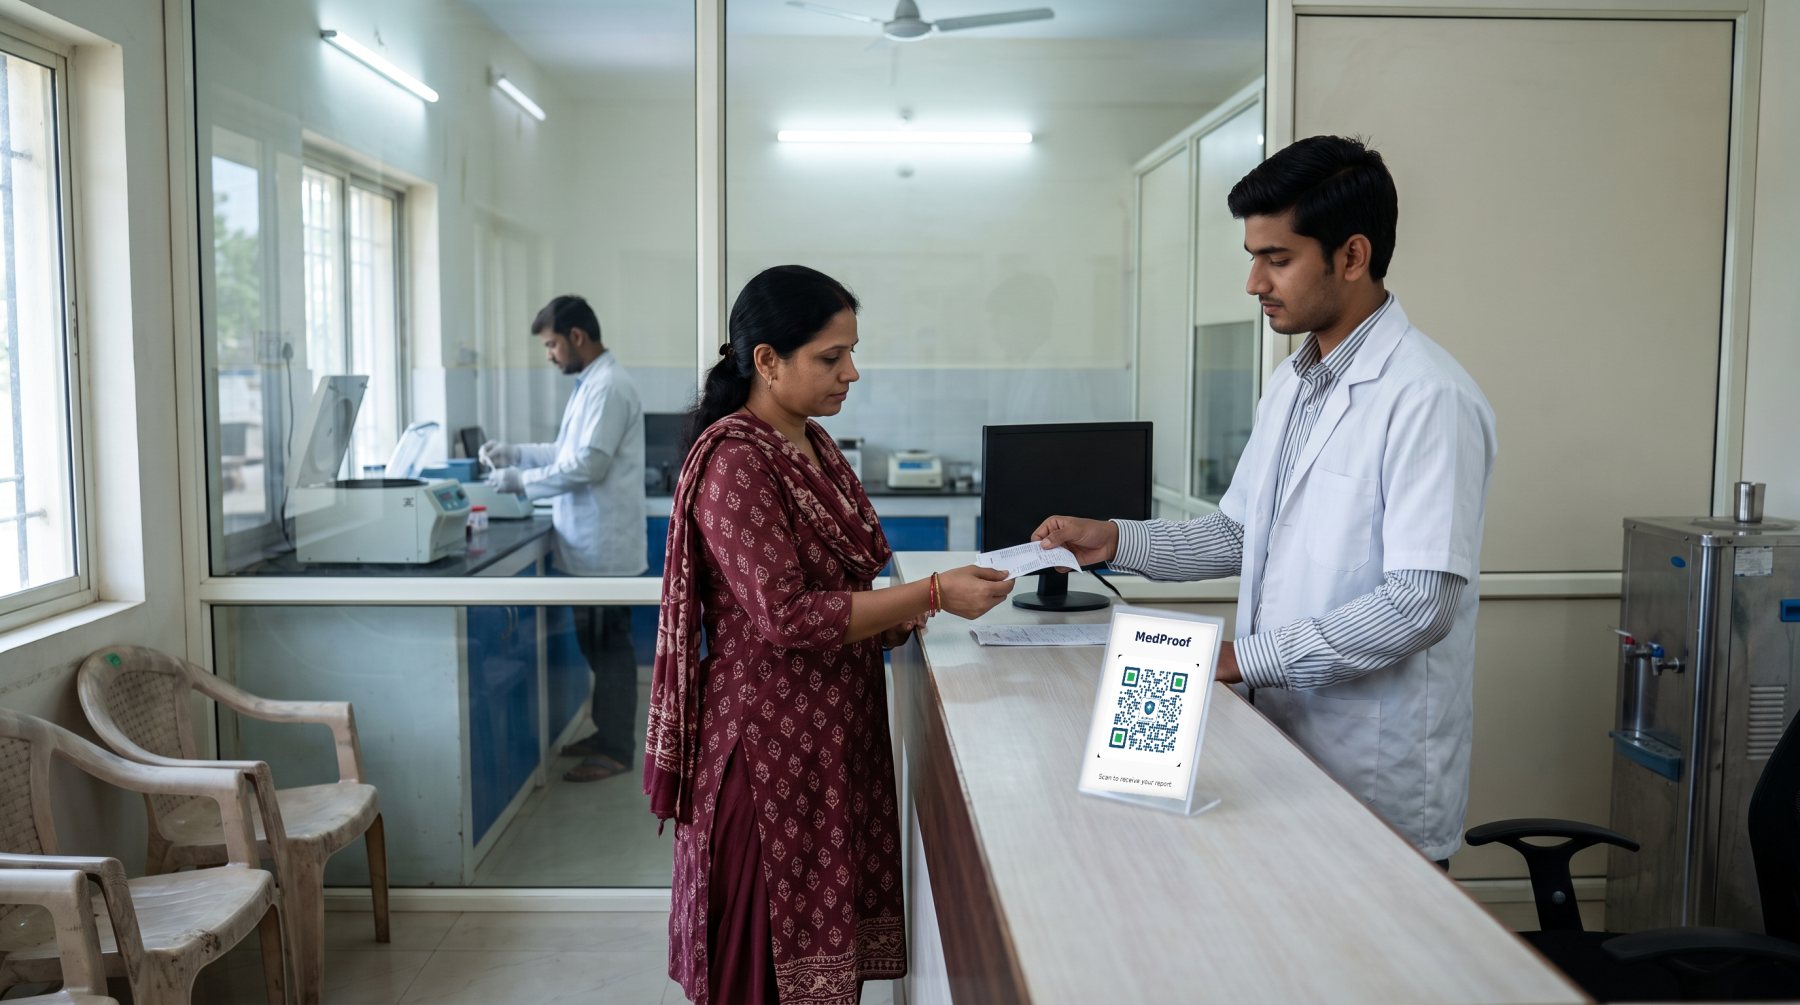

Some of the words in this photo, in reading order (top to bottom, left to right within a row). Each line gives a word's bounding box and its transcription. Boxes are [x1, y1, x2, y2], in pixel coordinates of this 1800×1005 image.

[1135, 630, 1192, 648] MedProof
[1098, 773, 1112, 781] Scan
[1120, 776, 1140, 784] receive
[1154, 780, 1172, 788] report
